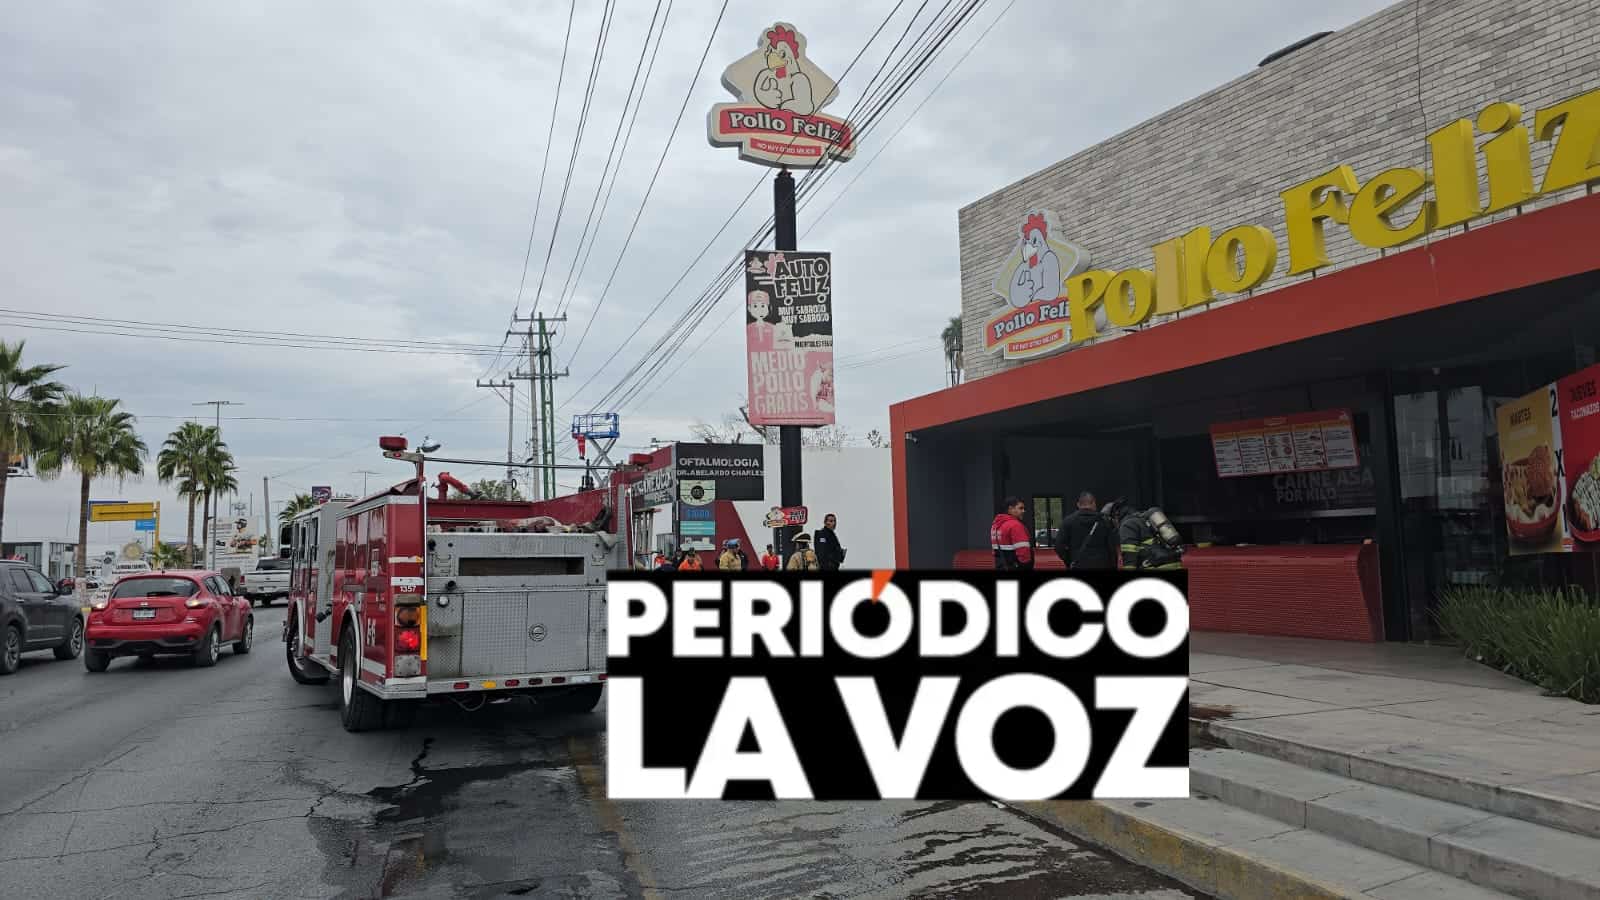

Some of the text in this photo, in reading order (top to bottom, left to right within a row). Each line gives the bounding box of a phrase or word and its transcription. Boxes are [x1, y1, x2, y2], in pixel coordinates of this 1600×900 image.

[729, 112, 842, 144] Pollo Feliz
[1066, 90, 1600, 344] Pollo Feliz
[775, 258, 829, 279] AUTO
[775, 276, 830, 298] FELIZ
[778, 304, 826, 315] MUY SABROSO
[782, 313, 829, 323] MUY SABROSO
[993, 301, 1070, 340] Pollo Feli
[751, 351, 806, 374] MEDIO
[752, 371, 805, 394] POLLO
[754, 391, 809, 415] GRATIS
[1550, 389, 1558, 418] 2
[1555, 449, 1565, 478] X
[679, 457, 760, 467] OFTALMOLOGIA
[1273, 471, 1333, 489] CARNE
[1276, 487, 1337, 504] POR KILO
[399, 585, 417, 593] 1357
